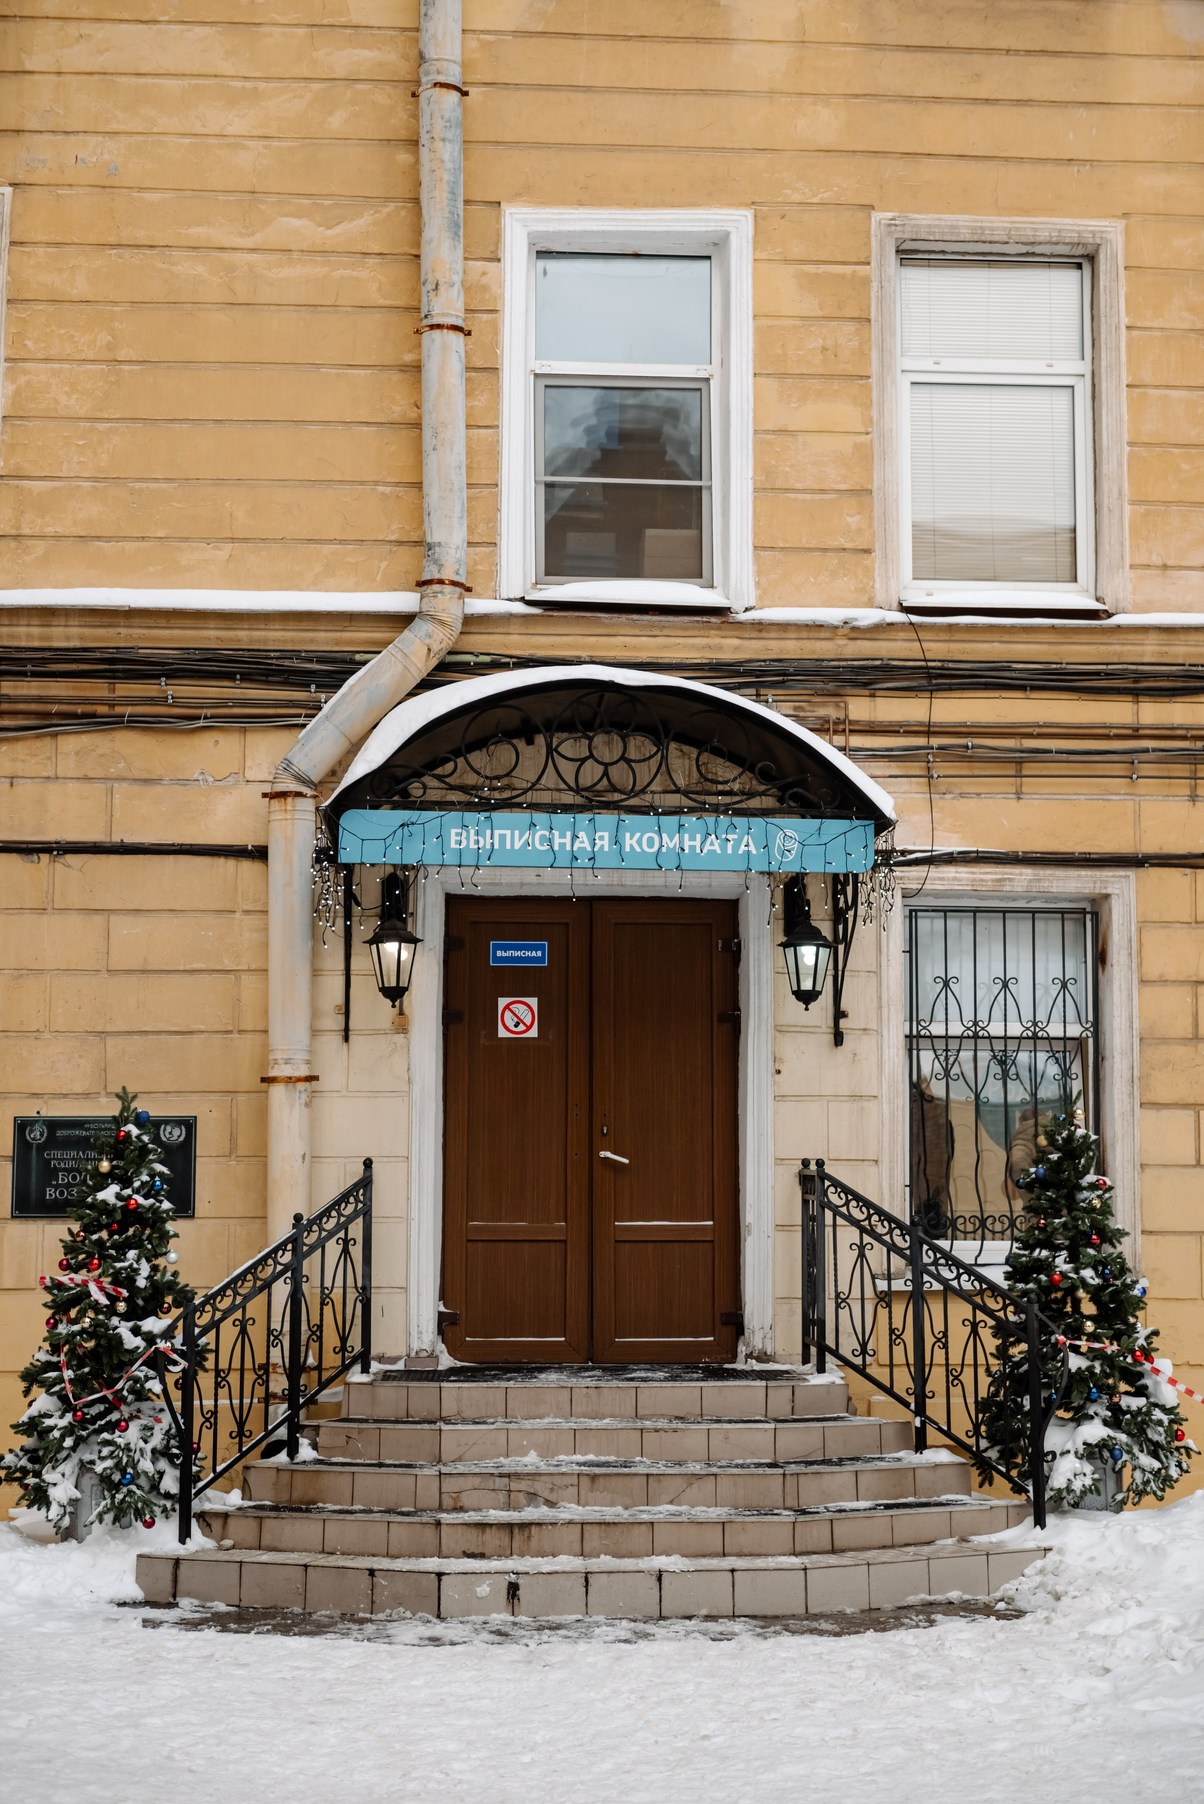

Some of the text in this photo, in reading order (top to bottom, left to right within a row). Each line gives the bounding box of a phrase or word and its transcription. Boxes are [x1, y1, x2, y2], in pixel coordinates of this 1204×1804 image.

[449, 828, 757, 855] ВЫПИСНАЯ КОМНАТА
[46, 1187, 77, 1200] ВОЗ
